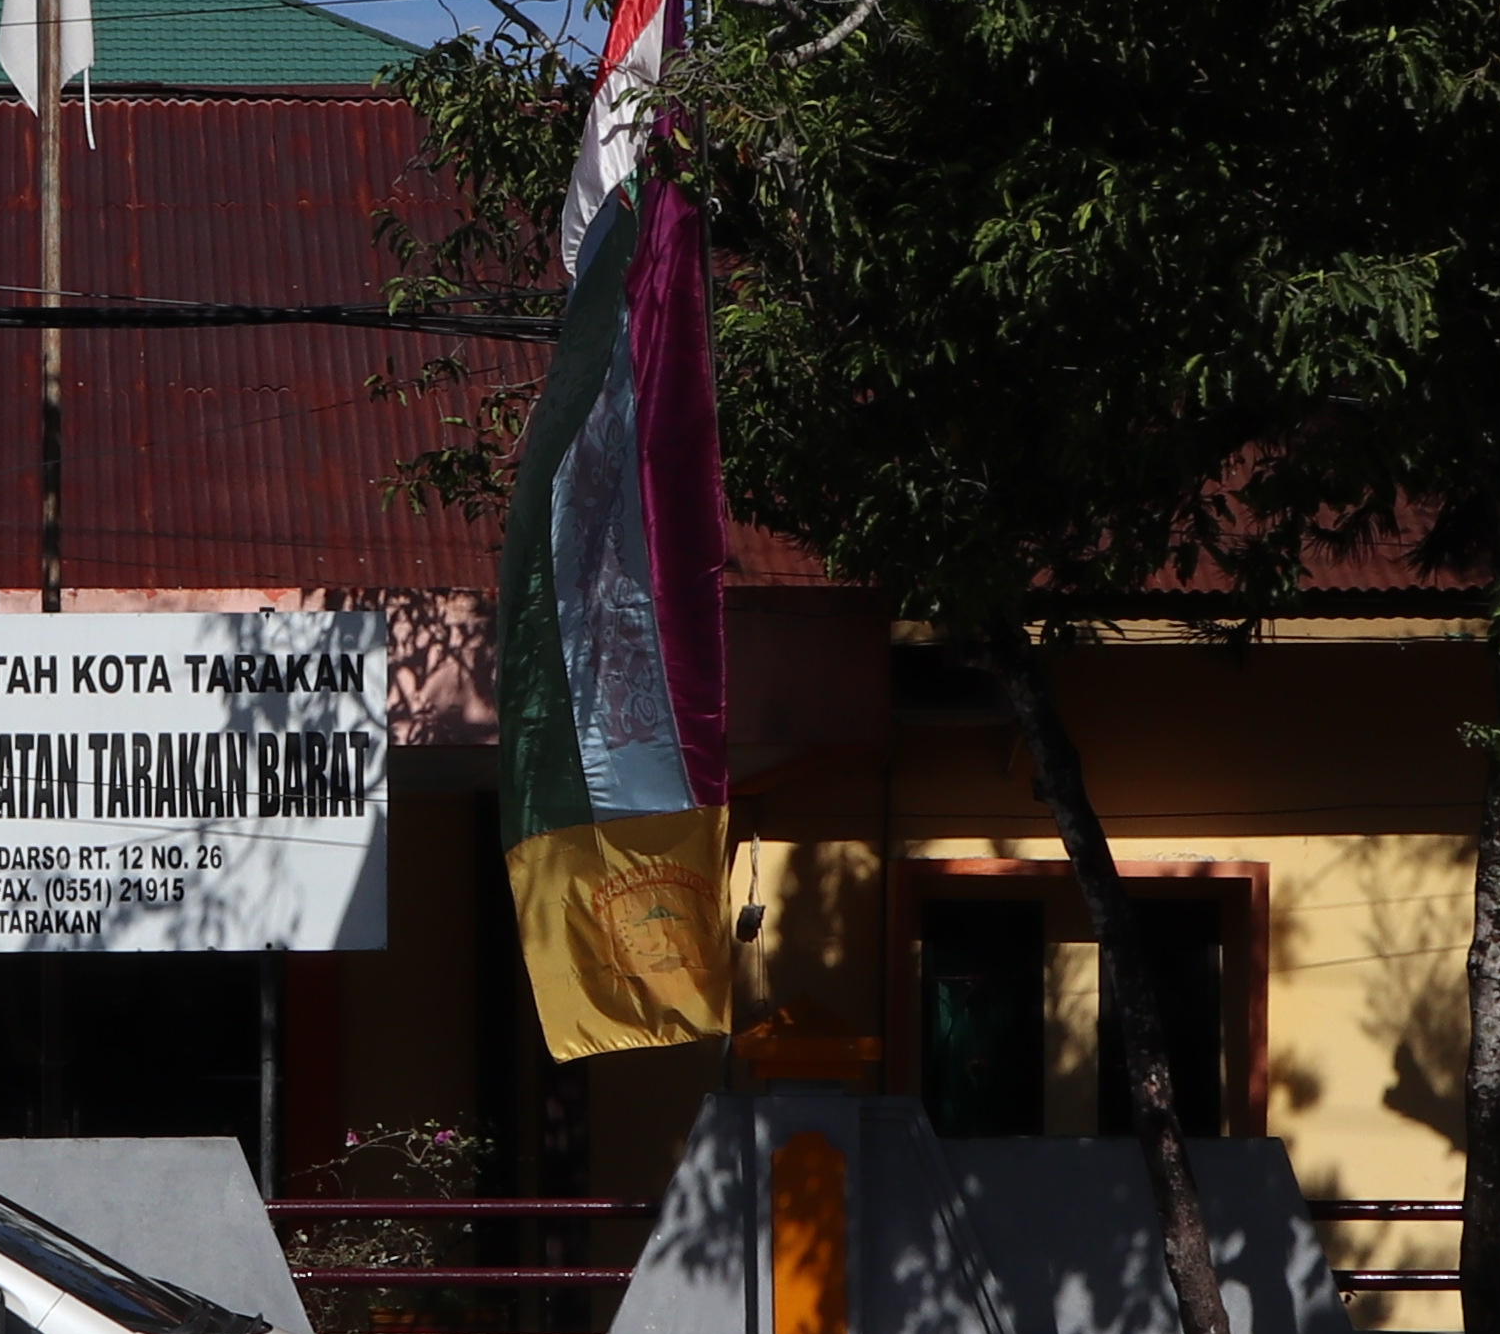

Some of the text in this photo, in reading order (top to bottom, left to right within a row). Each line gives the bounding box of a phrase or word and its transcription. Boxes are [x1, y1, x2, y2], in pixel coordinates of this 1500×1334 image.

[72, 654, 171, 693] KOTA
[184, 653, 364, 693] TARAKAN
[88, 732, 248, 819] TARAKAN
[258, 732, 369, 818] BARAT
[79, 846, 109, 869] RT.
[118, 846, 143, 869] 12
[152, 846, 188, 869] NO.
[196, 845, 222, 870] 26
[44, 877, 112, 907] (0551)
[120, 877, 184, 902] 21915
